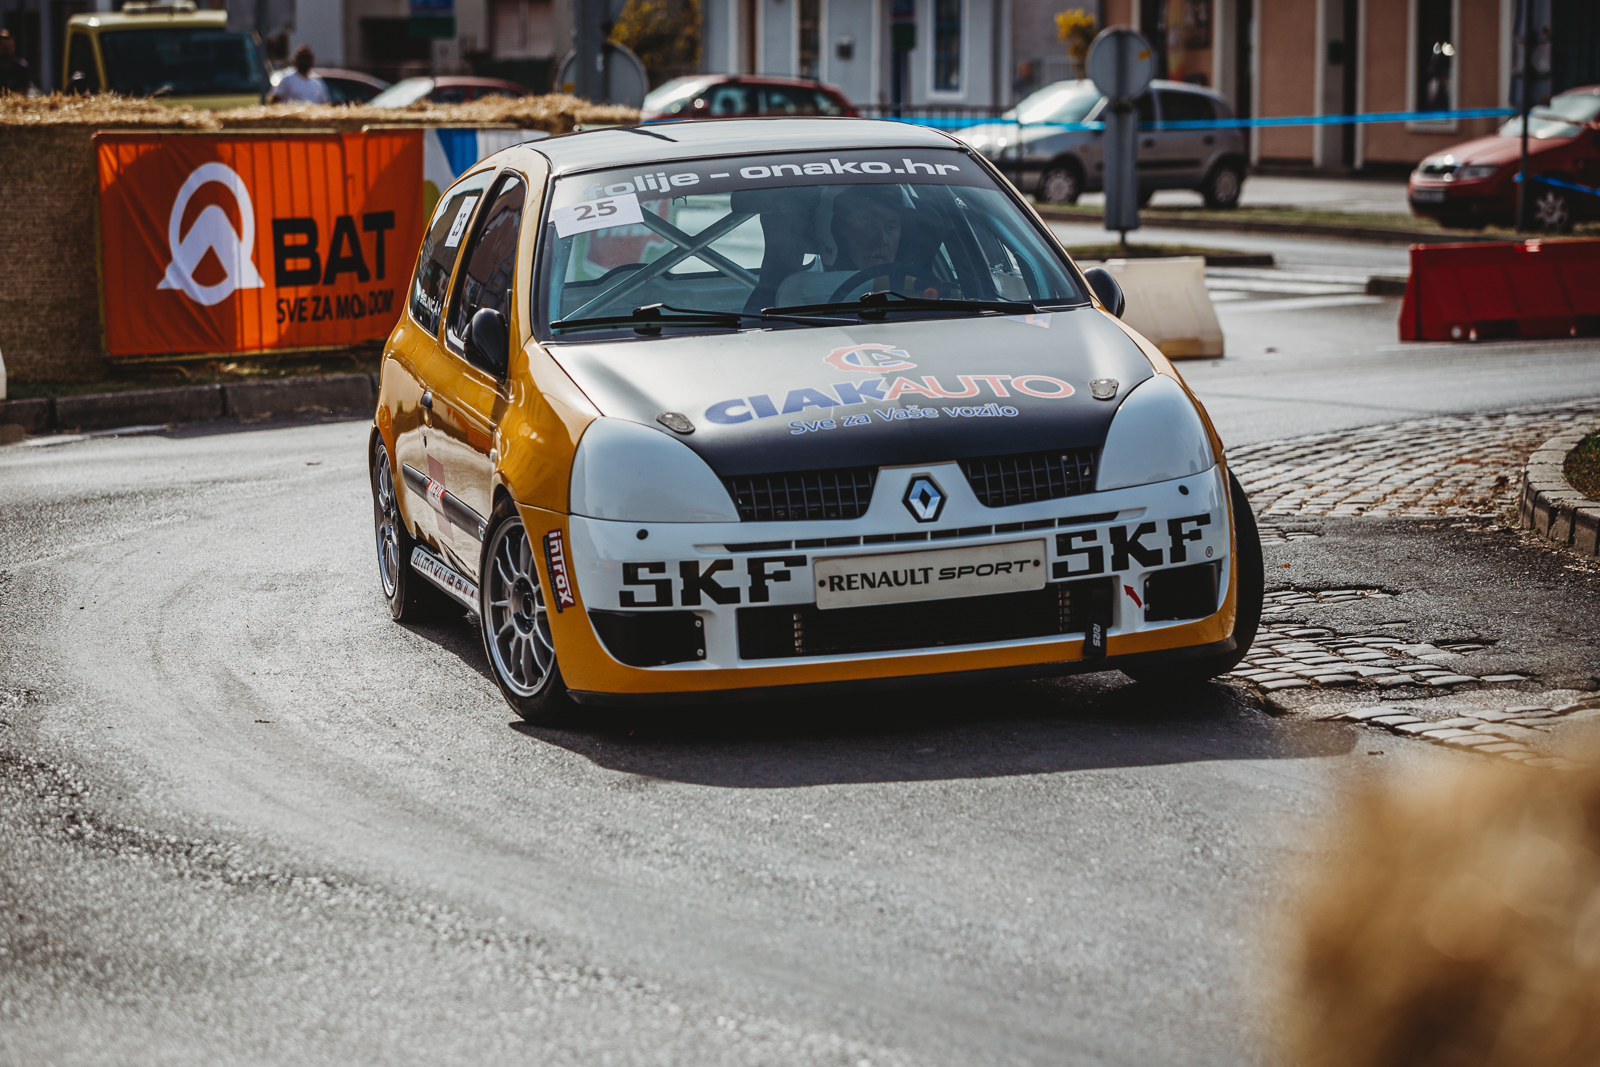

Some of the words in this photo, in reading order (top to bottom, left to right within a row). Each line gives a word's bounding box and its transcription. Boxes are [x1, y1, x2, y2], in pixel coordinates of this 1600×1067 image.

[583, 172, 700, 199] folije
[740, 158, 960, 179] onako.hr
[574, 200, 618, 221] 25
[272, 210, 395, 288] BAT
[276, 297, 308, 324] SVE
[311, 295, 333, 321] ZA
[789, 417, 836, 435] Sve
[841, 412, 872, 427] za
[873, 404, 939, 421] Vaše
[942, 402, 1019, 417] vozilo
[1052, 513, 1211, 579] SKF
[619, 555, 807, 607] SKF
[828, 567, 933, 592] RENAULT
[938, 559, 1031, 580] SPORT
[1093, 623, 1101, 647] RRS
